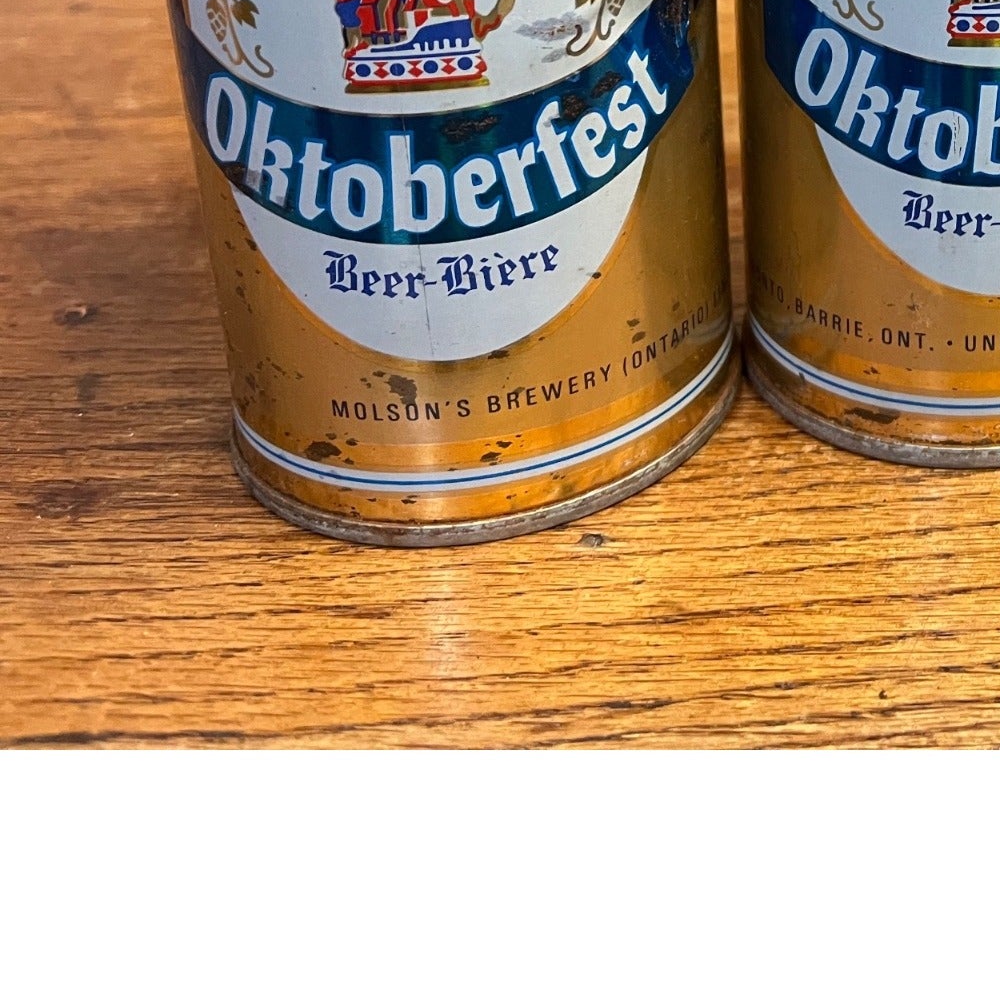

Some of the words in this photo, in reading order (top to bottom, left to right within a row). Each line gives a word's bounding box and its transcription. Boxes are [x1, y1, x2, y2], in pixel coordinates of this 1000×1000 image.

[206, 49, 669, 234] Oktoberfest
[325, 244, 561, 299] Beer-Bière
[331, 398, 471, 422] MOLSON'S
[487, 365, 611, 414] BREWERY
[622, 300, 710, 377] (ONTARIO)
[880, 327, 935, 352] ONT.
